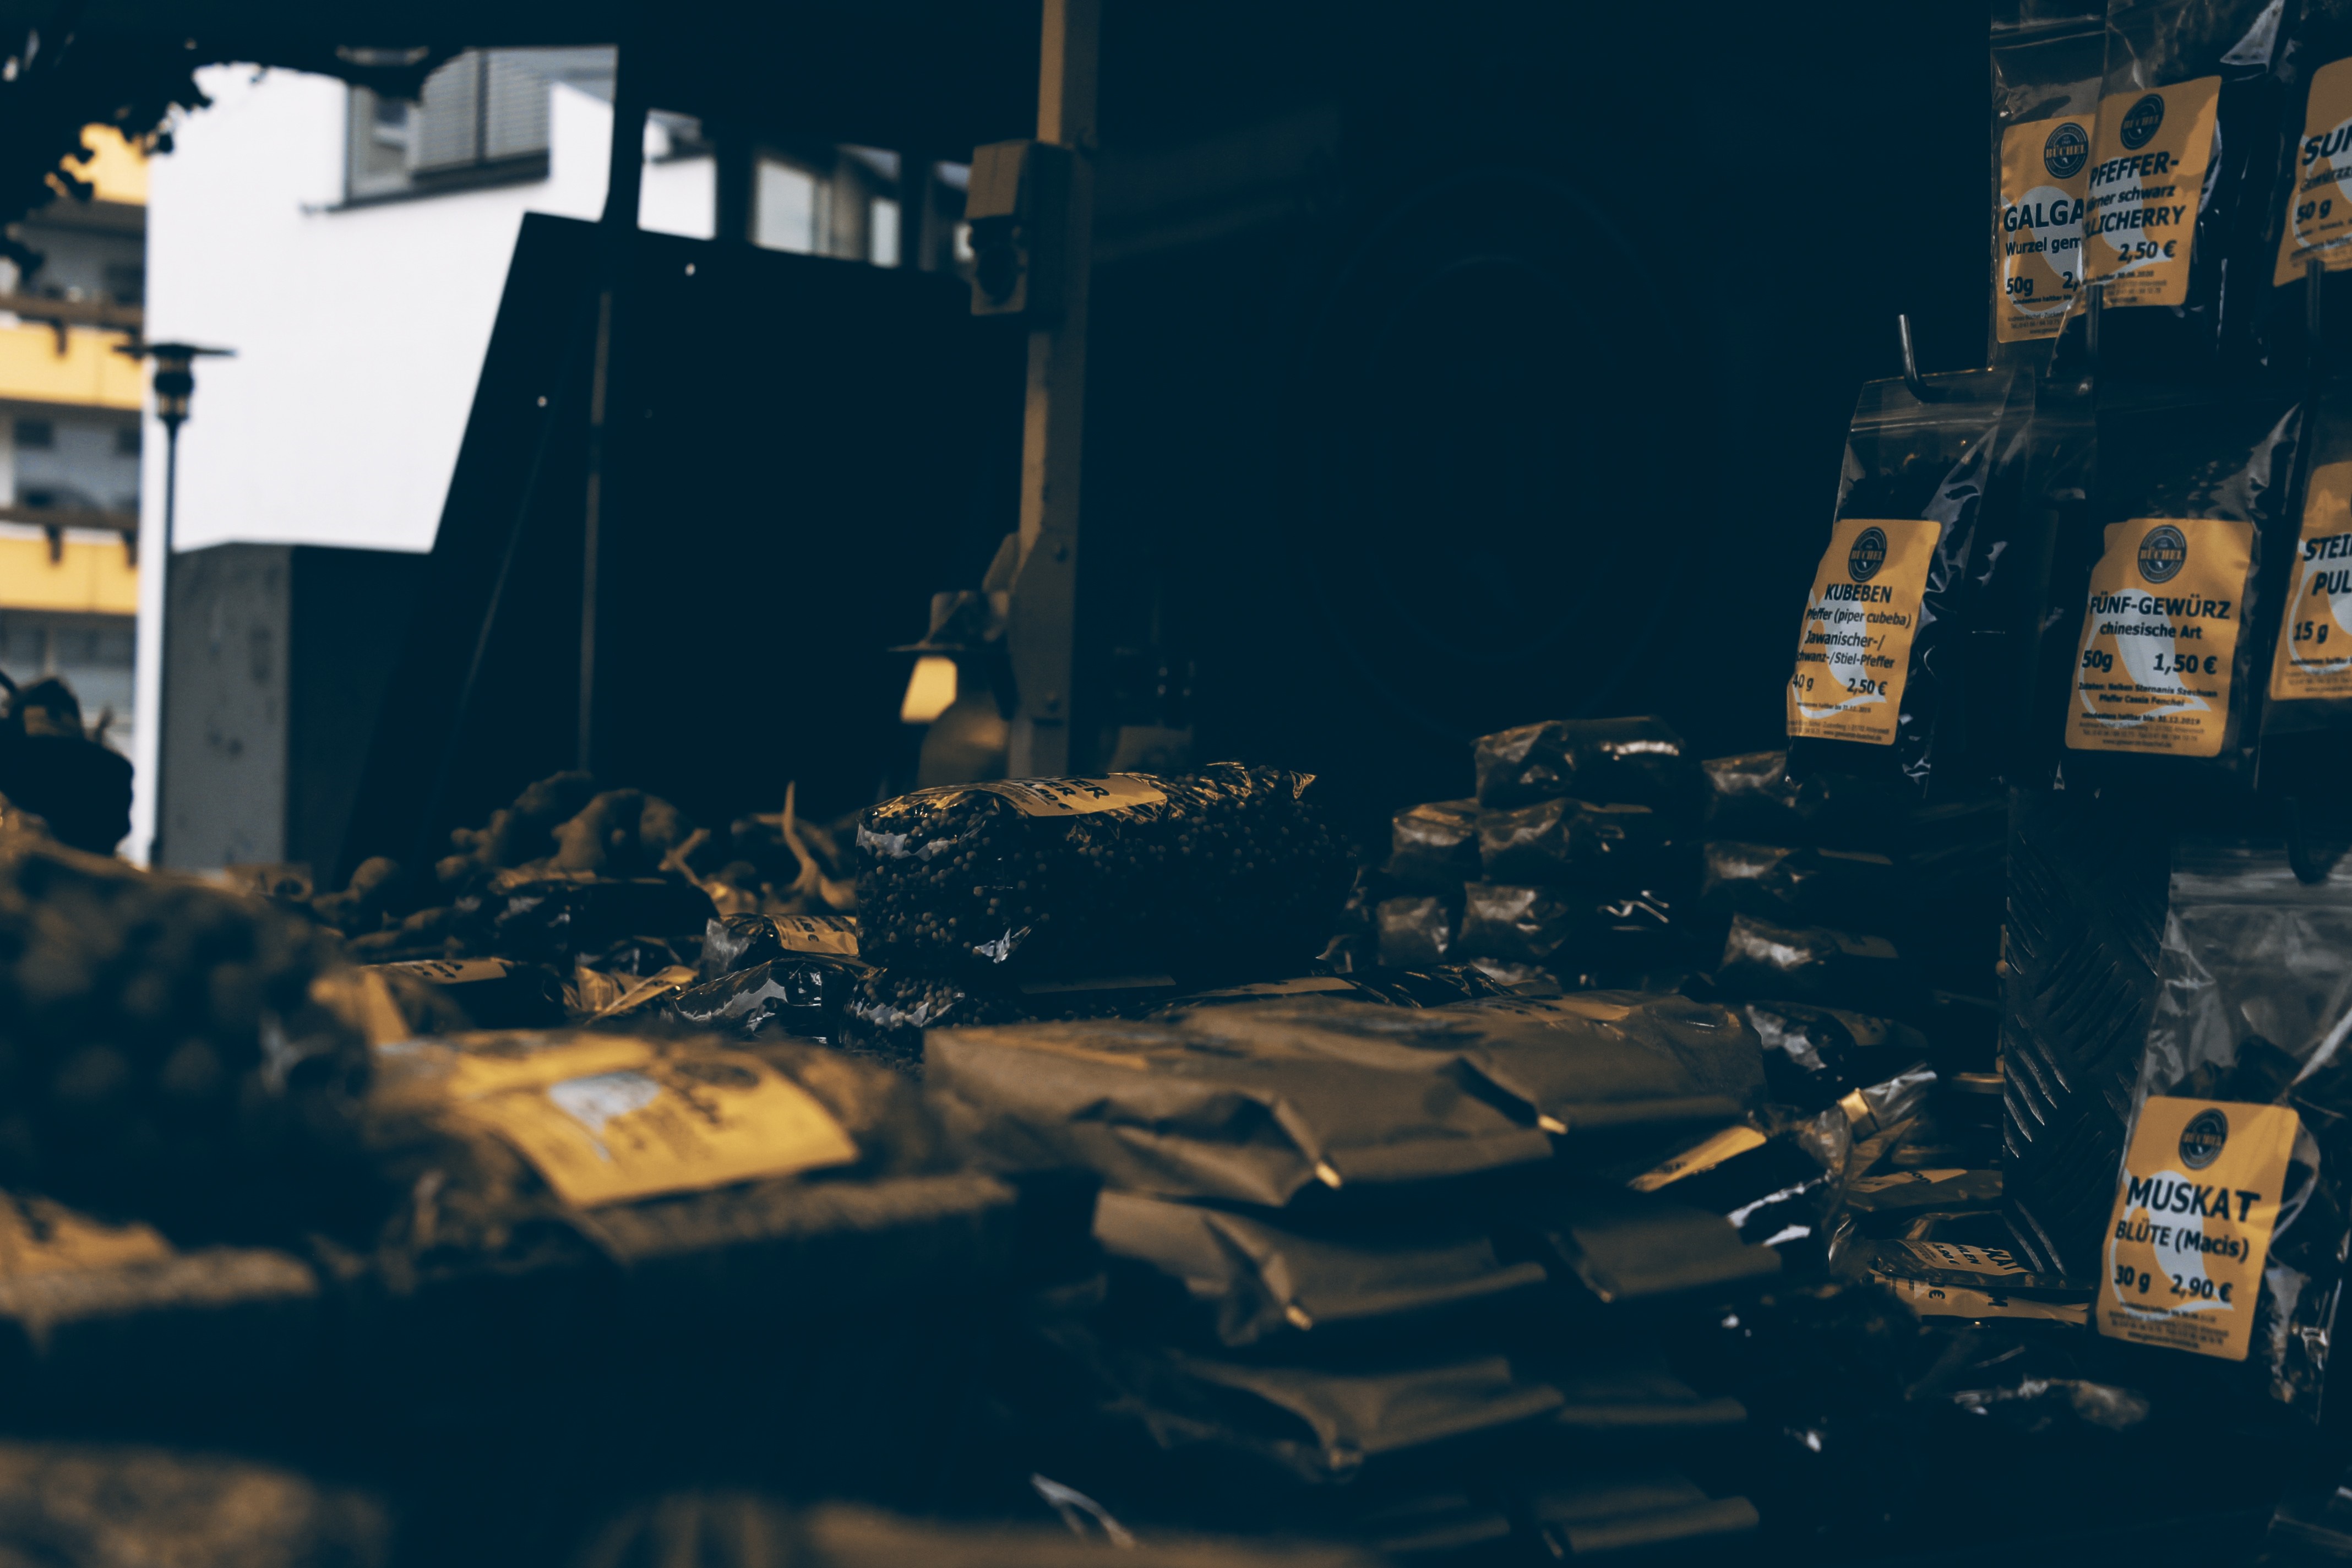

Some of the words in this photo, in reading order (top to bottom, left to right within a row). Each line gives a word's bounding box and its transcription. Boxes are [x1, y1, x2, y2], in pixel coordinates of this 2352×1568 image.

[2089, 151, 2179, 190] PFEFFER-
[2118, 186, 2177, 204] schwarz
[2003, 198, 2084, 232] GALGA
[2296, 200, 2316, 225] 50
[2319, 199, 2332, 219] g
[2006, 237, 2047, 256] Wurzel
[2117, 241, 2159, 263] 2,50
[2164, 239, 2177, 258] €
[2006, 276, 2033, 297] 50g
[1825, 584, 1892, 603] KUBEBEN
[2089, 591, 2231, 619] FÜNF-GEWÜRZ
[1805, 608, 1833, 620] Pfeffer
[1834, 608, 1864, 624] (piper
[1867, 611, 1912, 629] cubeba)
[2099, 620, 2177, 638] chinesische
[2180, 625, 2202, 639] Art
[1804, 630, 1886, 651] Jawanischer-/
[2294, 621, 2314, 641] 15
[2317, 624, 2328, 644] g
[2082, 650, 2113, 673] 50g
[2153, 653, 2198, 676] 1,50
[2203, 656, 2217, 675] €
[1793, 673, 1805, 689] 40
[1806, 678, 1814, 692] g
[1847, 677, 1875, 695] 2,50
[1877, 680, 1888, 696] €
[2126, 1176, 2261, 1223] MUSKAT
[2115, 1217, 2171, 1247] BLÜTE
[2175, 1227, 2249, 1264] (Macis)
[2114, 1264, 2135, 1287] 30
[2139, 1272, 2151, 1295] g
[2170, 1273, 2214, 1300] 2,90
[2219, 1282, 2234, 1303] €
